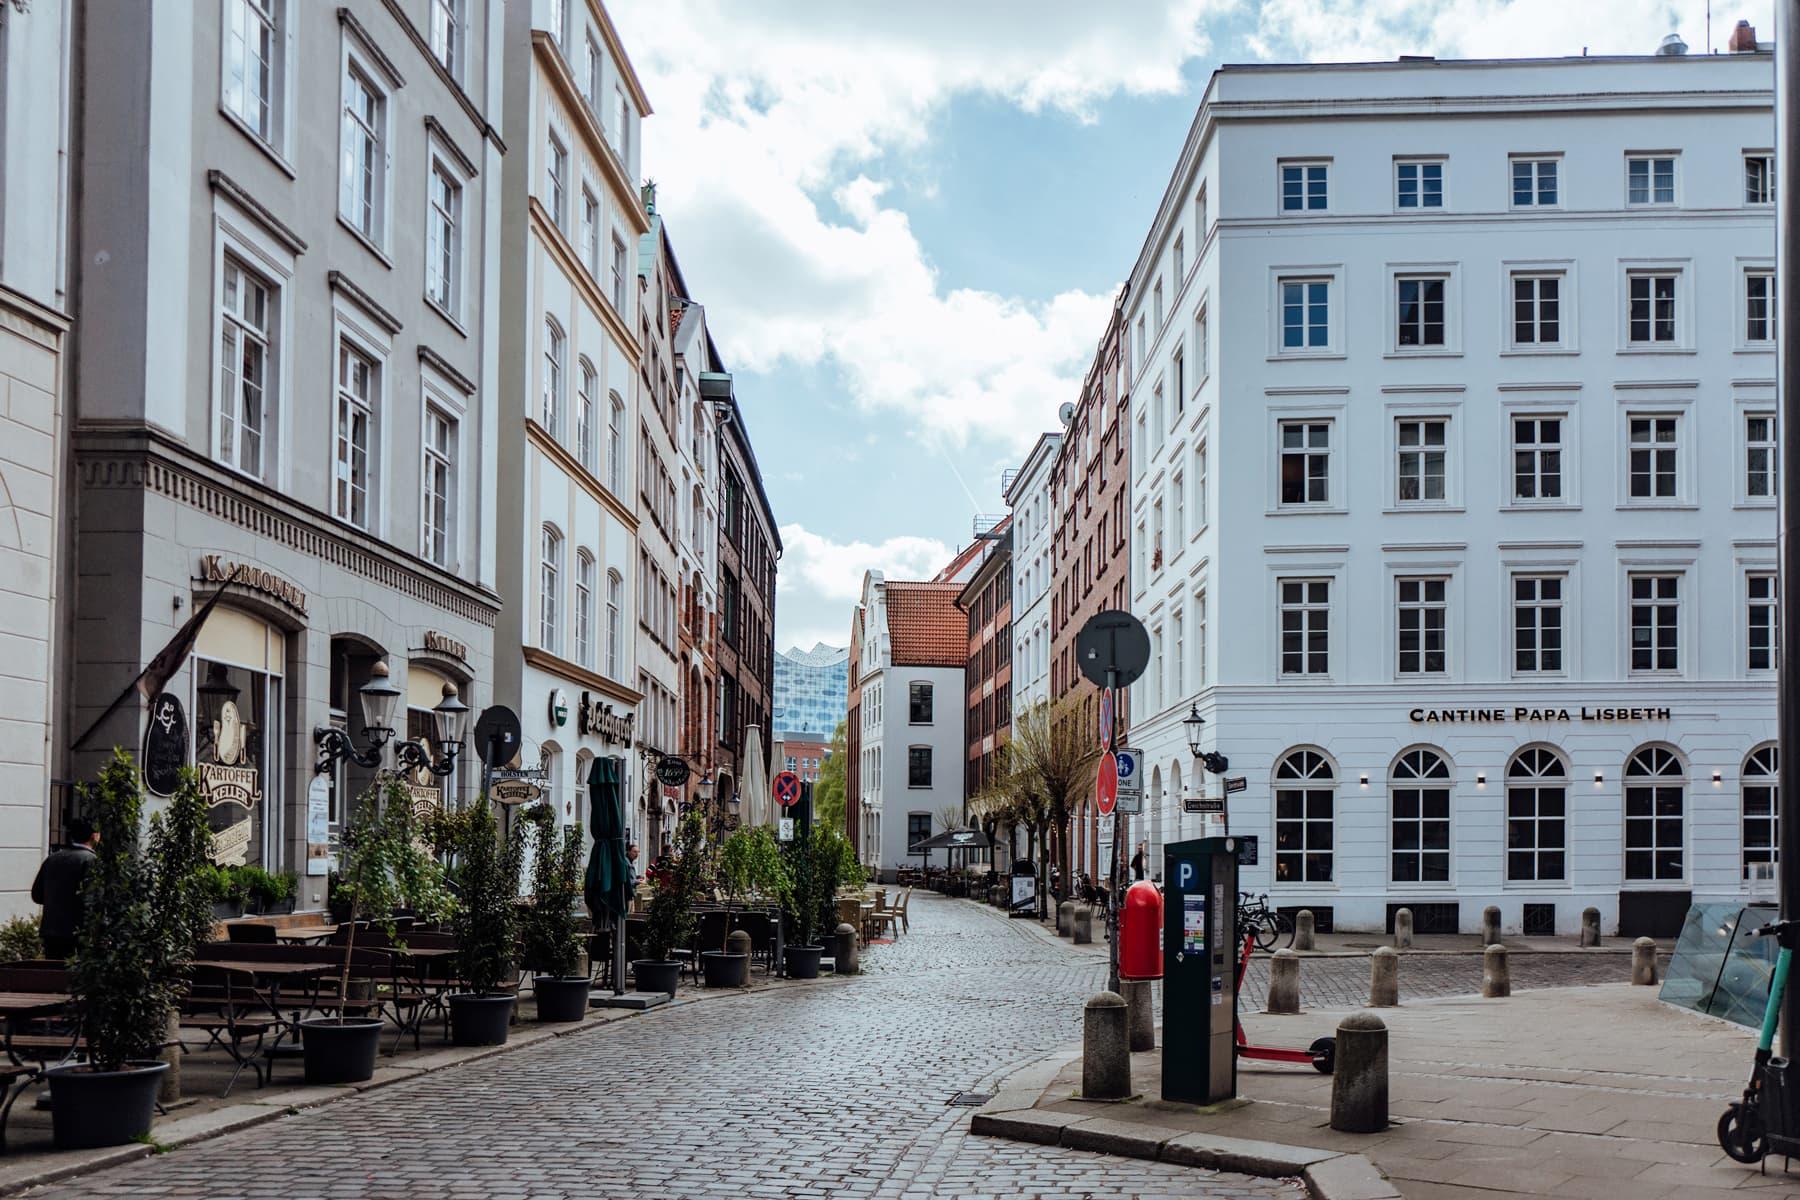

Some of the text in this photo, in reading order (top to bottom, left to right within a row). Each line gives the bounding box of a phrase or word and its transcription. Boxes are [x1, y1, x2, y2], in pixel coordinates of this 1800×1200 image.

[205, 554, 309, 615] KARTOFFEL
[426, 630, 467, 660] KELLER
[1409, 707, 1671, 722] CANTINE PAPA LISBETH
[199, 764, 261, 799] KARTOFFEL
[1117, 779, 1132, 787] ONE
[212, 785, 249, 805] KELLER
[1180, 863, 1193, 888] P
